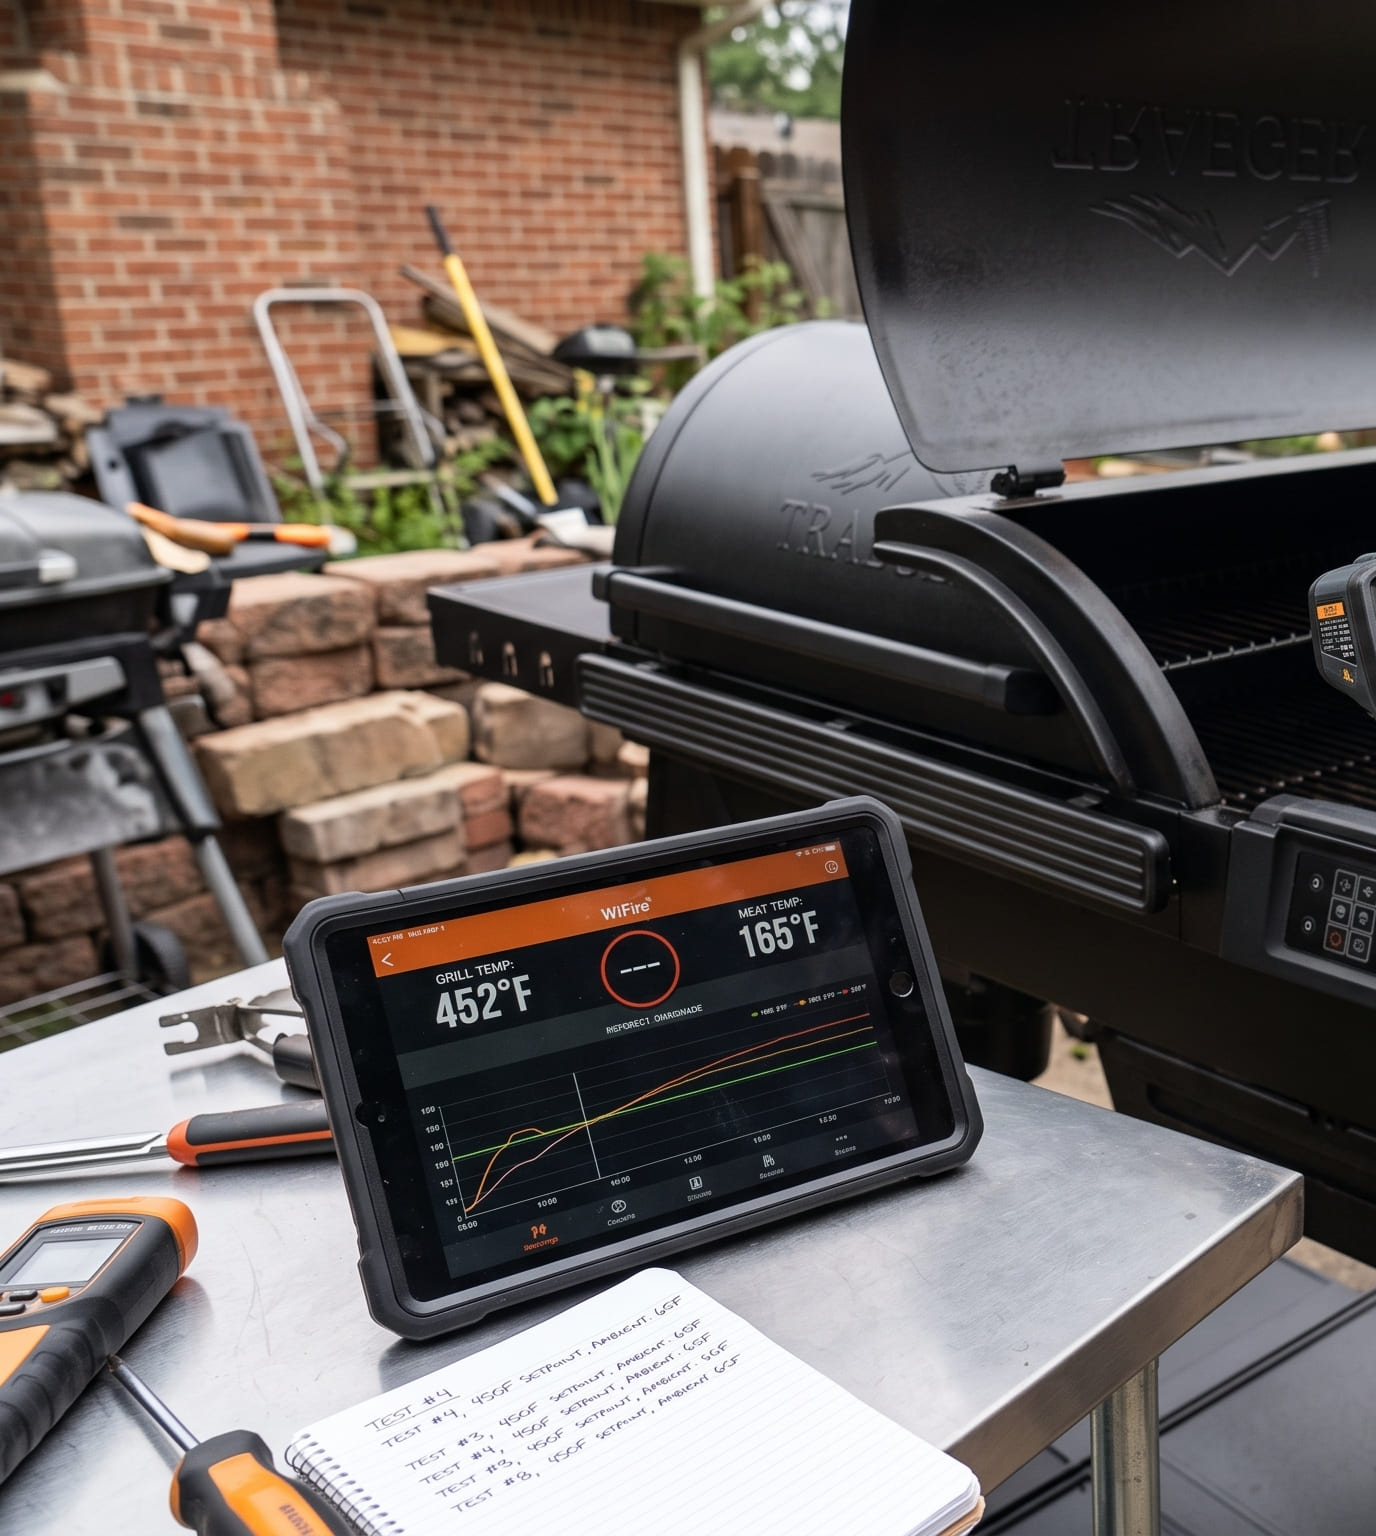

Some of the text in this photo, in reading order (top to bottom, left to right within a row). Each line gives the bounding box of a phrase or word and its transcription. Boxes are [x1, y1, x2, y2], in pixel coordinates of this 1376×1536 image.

[738, 897, 803, 919] MEAT TEMP:
[739, 910, 819, 957] 165°F
[436, 960, 515, 985] GRILL TEMP:
[436, 974, 532, 1028] 452°F
[364, 1388, 453, 1430] TEST #4
[380, 1425, 421, 1447] TEST
[405, 1448, 446, 1471] TEST
[418, 1461, 460, 1484] TEST
[434, 1474, 476, 1498] TEST
[450, 1488, 494, 1512] TEST
